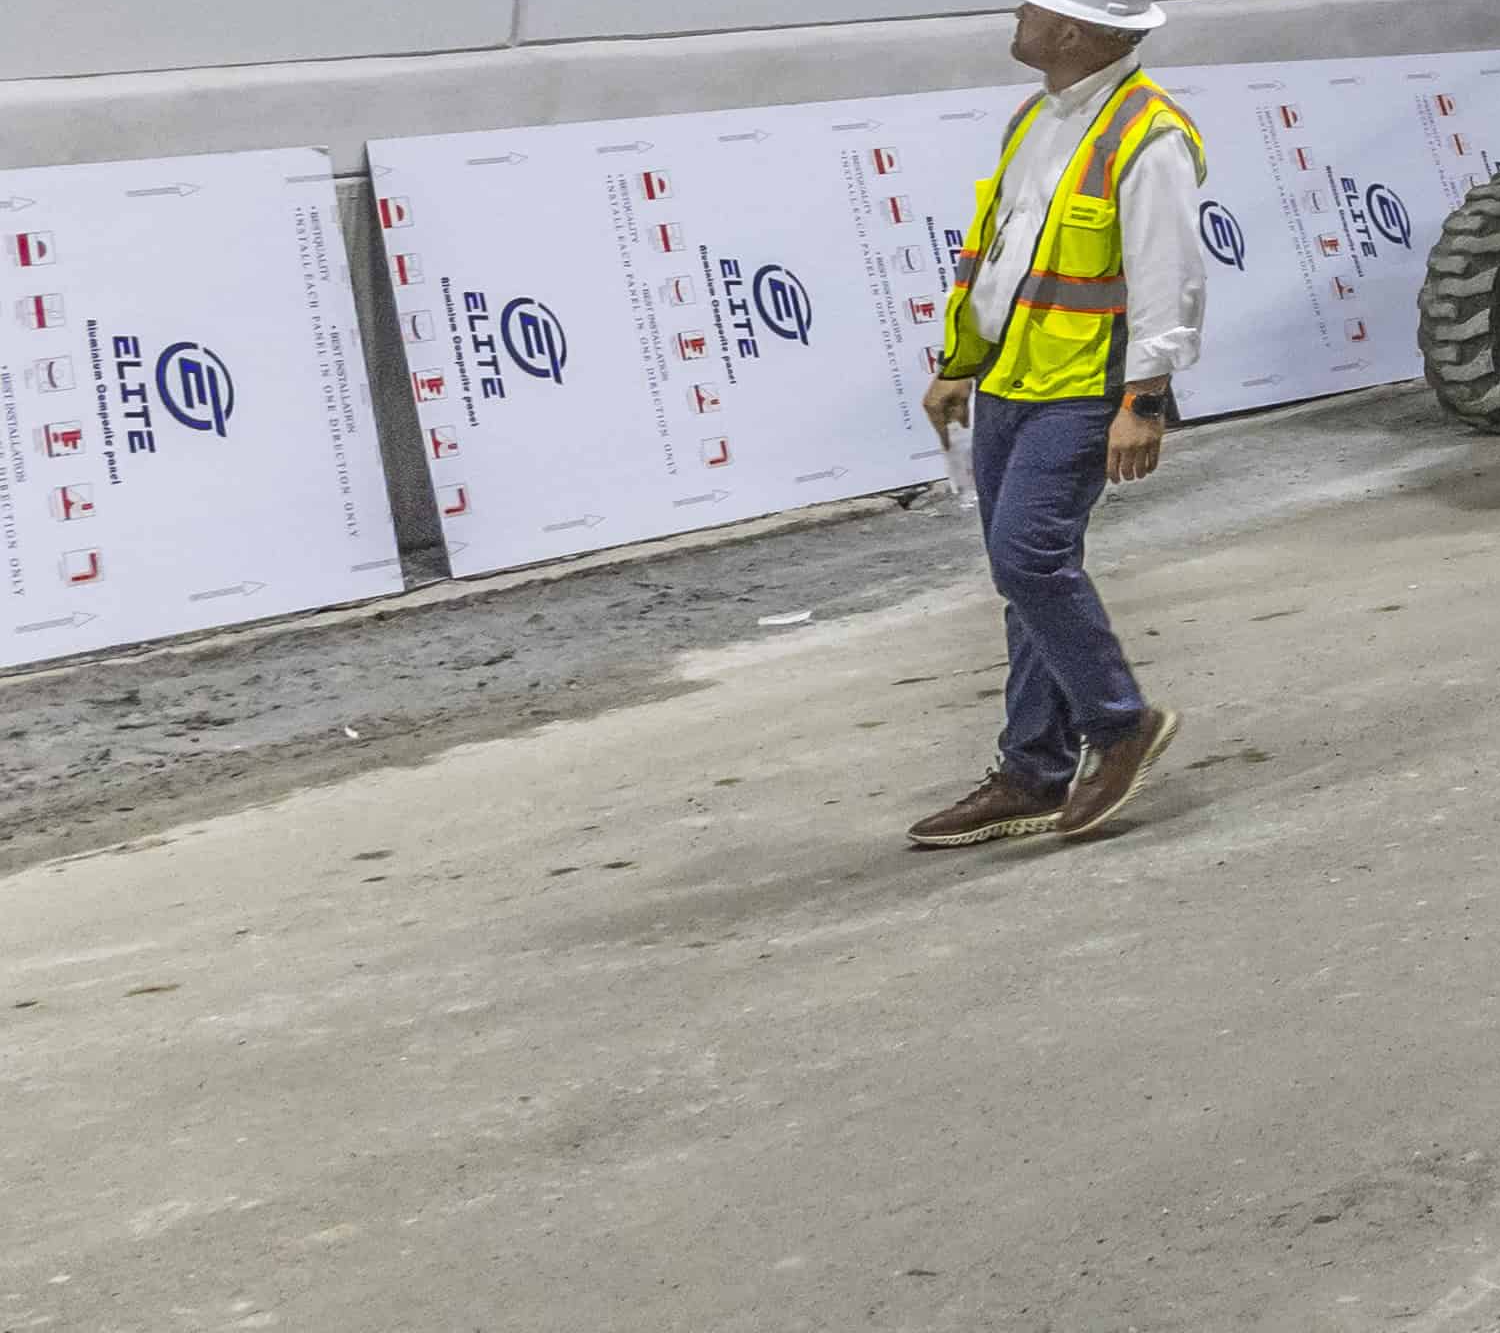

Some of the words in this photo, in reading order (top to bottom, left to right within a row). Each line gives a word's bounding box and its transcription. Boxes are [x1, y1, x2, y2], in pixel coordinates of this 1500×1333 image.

[1340, 177, 1378, 258] ELITE
[304, 273, 319, 308] EACH
[625, 272, 640, 314] PANEL
[699, 245, 717, 296] Aluminium
[722, 354, 736, 385] panel
[719, 259, 759, 358] ELITE
[312, 316, 327, 355] PANEL
[319, 363, 330, 377] IN
[440, 277, 458, 332] Aluminium
[462, 395, 480, 427] panel
[463, 291, 505, 399] ELITE
[640, 336, 653, 363] ONE
[86, 319, 103, 382] Aluminium
[104, 450, 122, 485] panel
[112, 335, 156, 454] ELITE
[323, 384, 336, 412] ONE
[335, 360, 356, 434] INSTALLATION
[646, 368, 668, 437] DIRECTION
[5, 402, 26, 483] INSTALLATION
[329, 418, 352, 494] DIRECTION
[664, 442, 677, 475] ONLY
[344, 501, 359, 537] ONLY
[9, 557, 25, 595] ONLY
